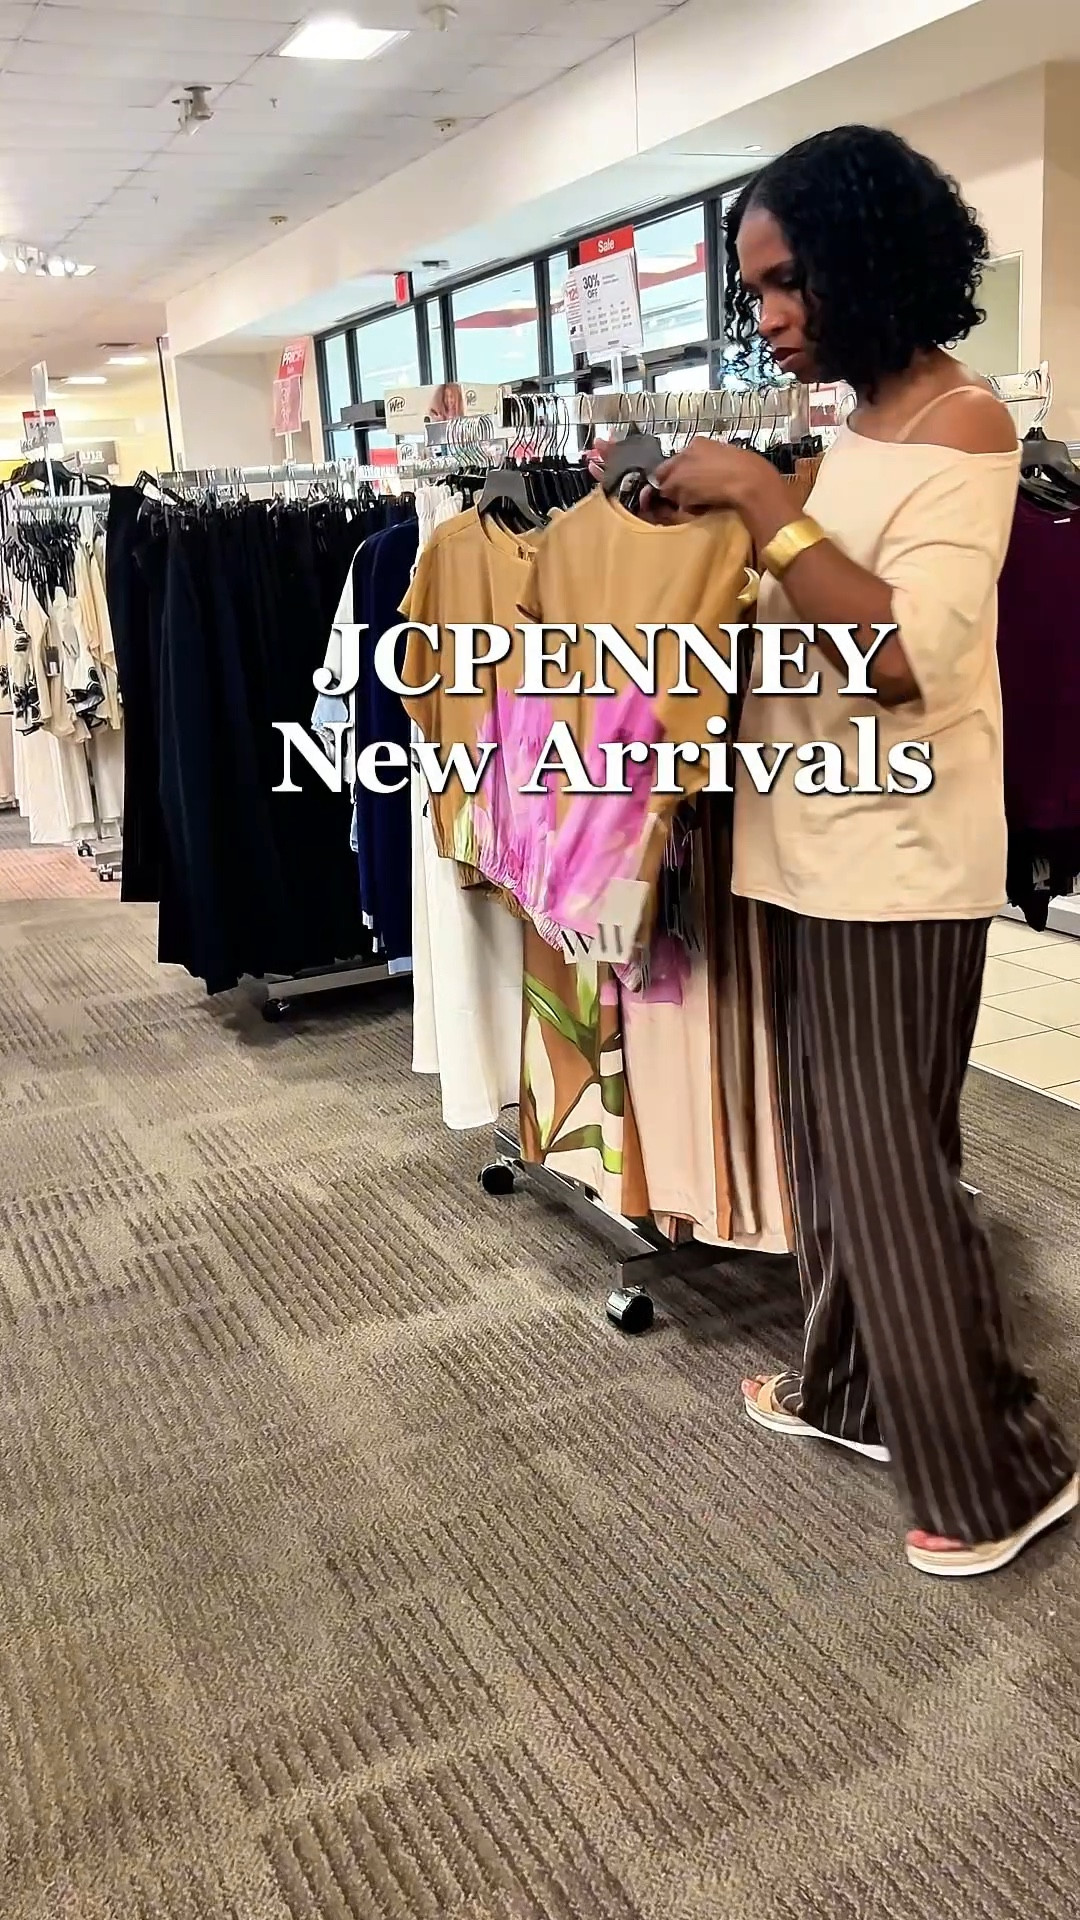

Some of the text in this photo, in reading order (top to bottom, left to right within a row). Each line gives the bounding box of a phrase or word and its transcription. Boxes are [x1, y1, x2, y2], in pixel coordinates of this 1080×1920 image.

[598, 238, 615, 253] Sale
[583, 273, 600, 289] 30%
[587, 289, 598, 299] OFF
